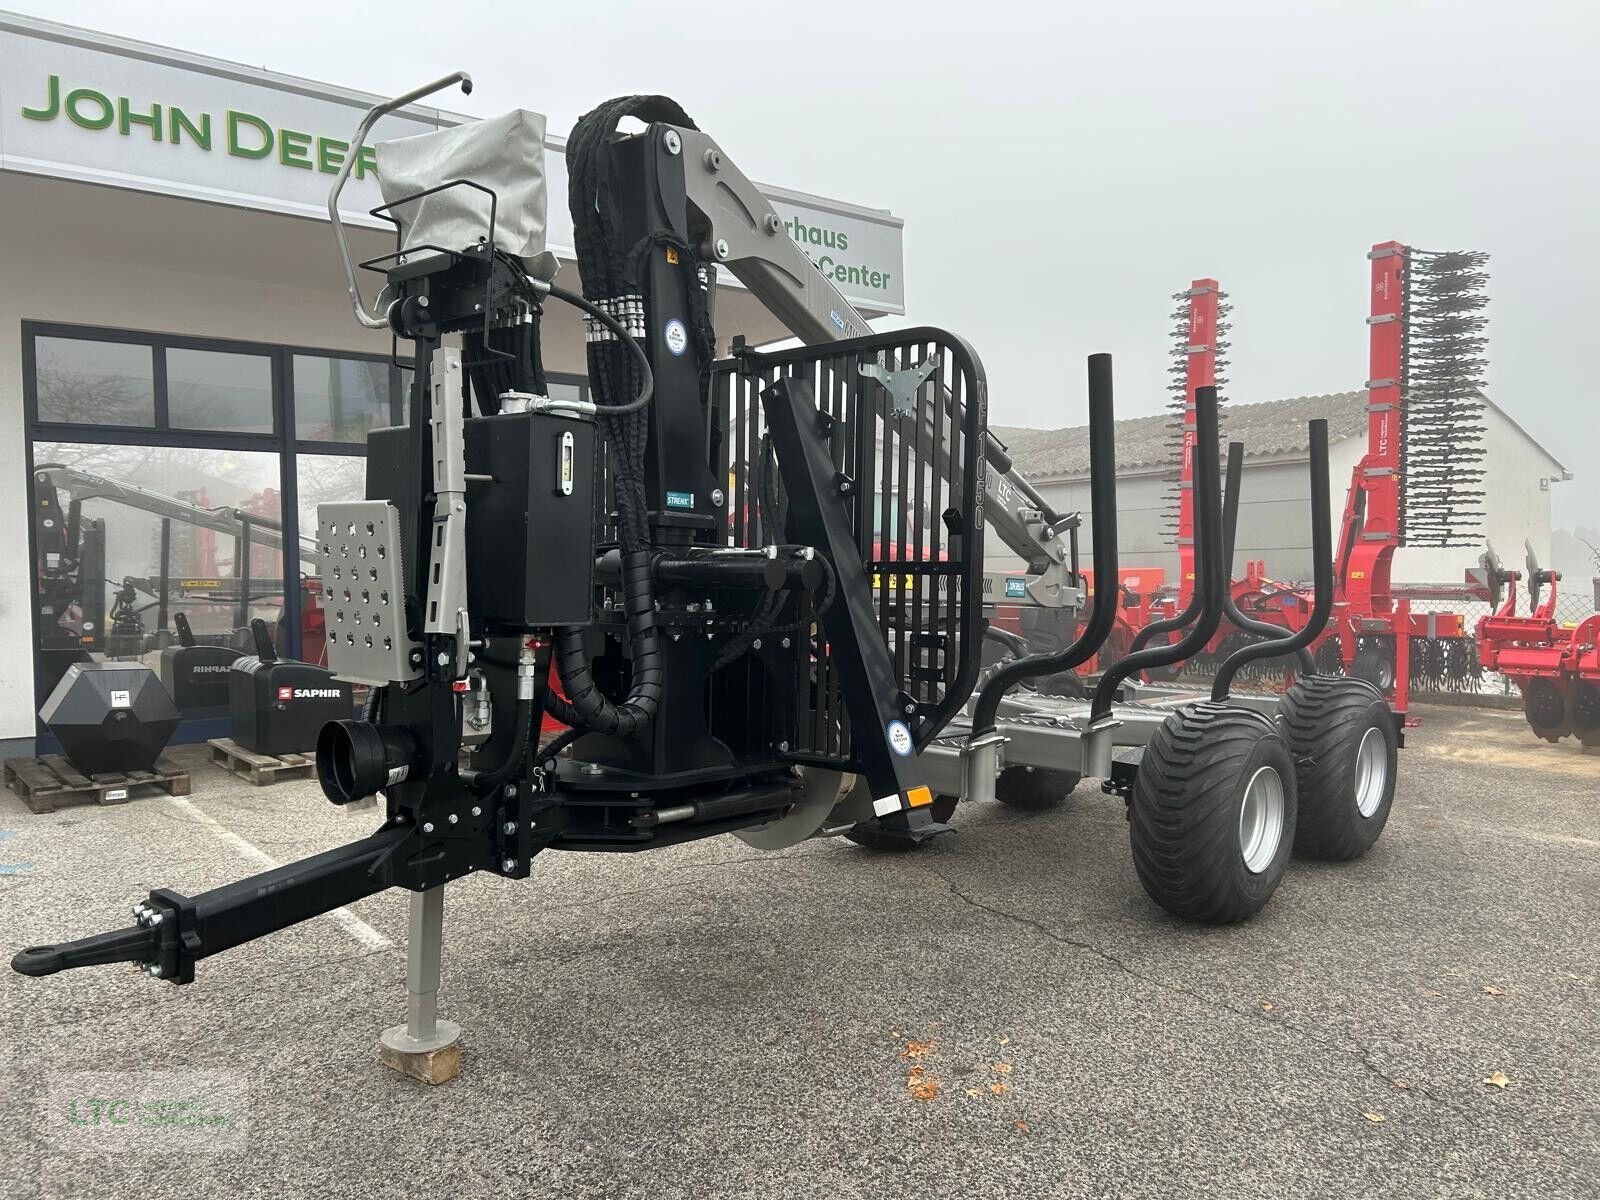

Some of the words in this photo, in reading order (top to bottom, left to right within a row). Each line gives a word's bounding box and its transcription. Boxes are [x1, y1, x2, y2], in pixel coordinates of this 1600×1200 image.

[21, 73, 212, 151] JOHN
[819, 255, 890, 290] Center
[974, 431, 987, 530] 1050
[998, 480, 1012, 502] LTC
[293, 688, 341, 698] SAPHIR
